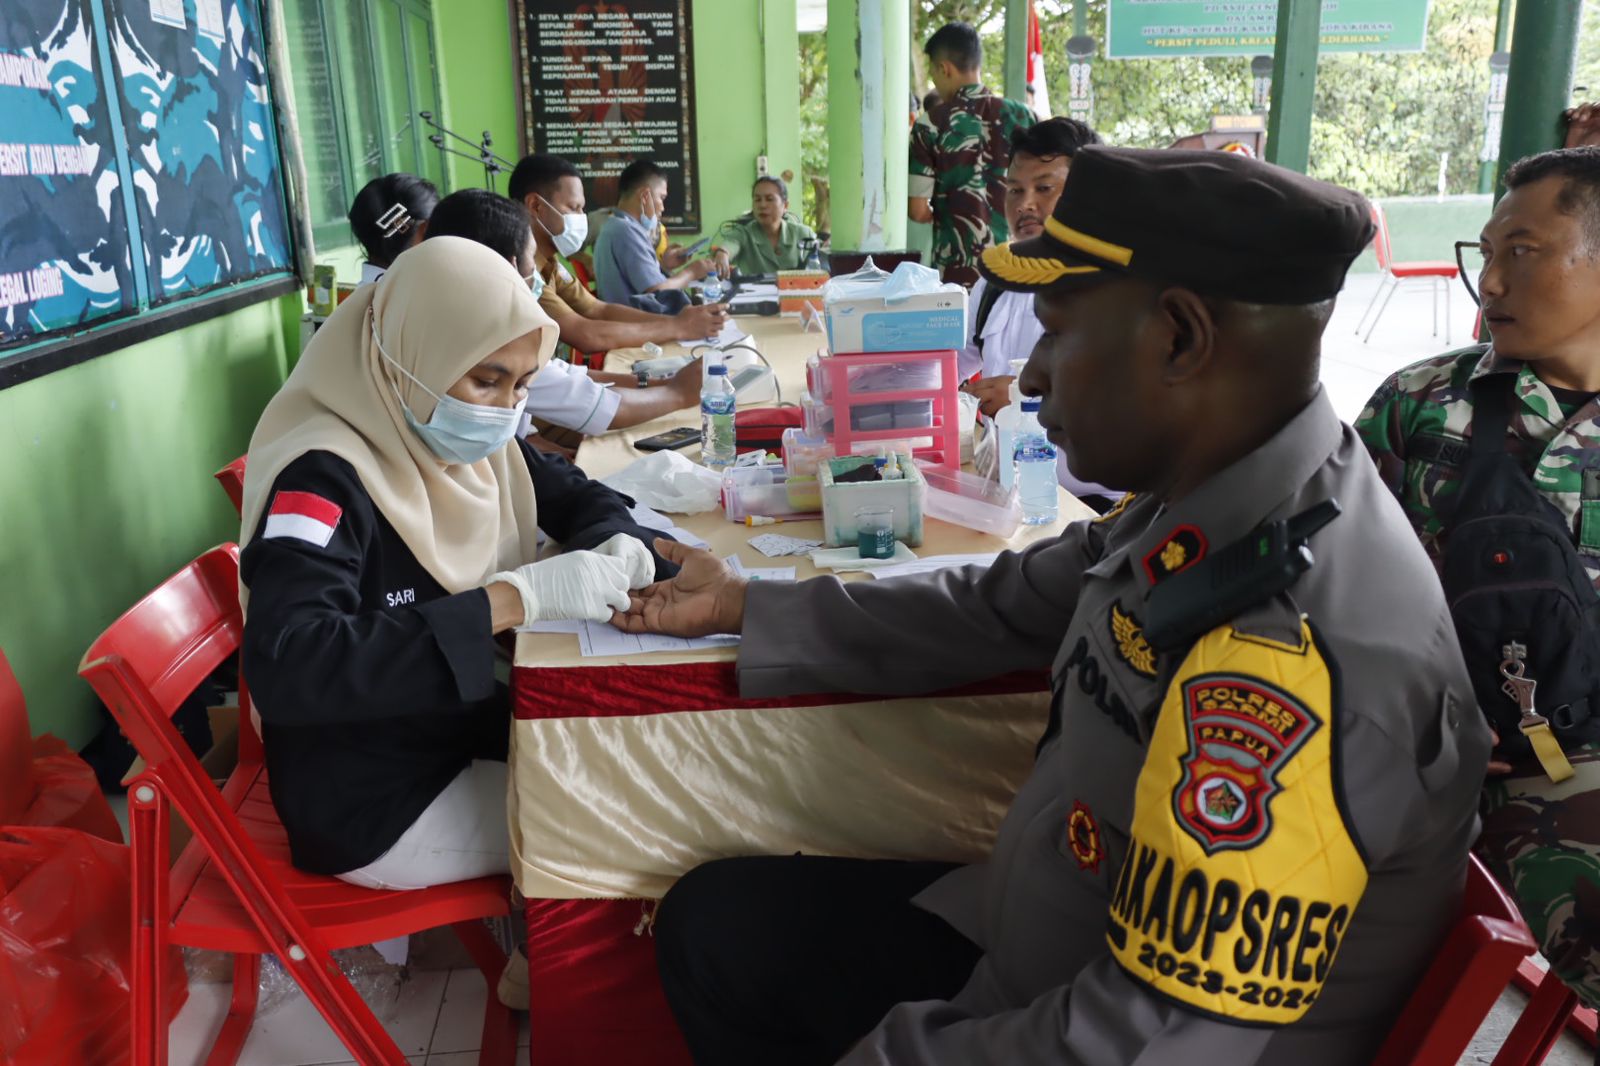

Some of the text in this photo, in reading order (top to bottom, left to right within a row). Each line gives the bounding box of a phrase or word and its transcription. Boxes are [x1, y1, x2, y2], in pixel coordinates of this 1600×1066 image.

[608, 38, 634, 46] DASAR
[1320, 35, 1380, 44] EDERHANA
[543, 89, 565, 97] TAAT
[544, 97, 567, 105] TIDAK
[546, 122, 602, 130] MENJALANKAN
[546, 130, 578, 138] DENGAN
[547, 146, 579, 154] NEGARA
[0, 271, 29, 308] EGAL
[386, 588, 415, 607] SARI
[1196, 687, 1297, 728] POLRES
[1202, 699, 1290, 734] SARMI
[1202, 726, 1270, 760] PAPUA
